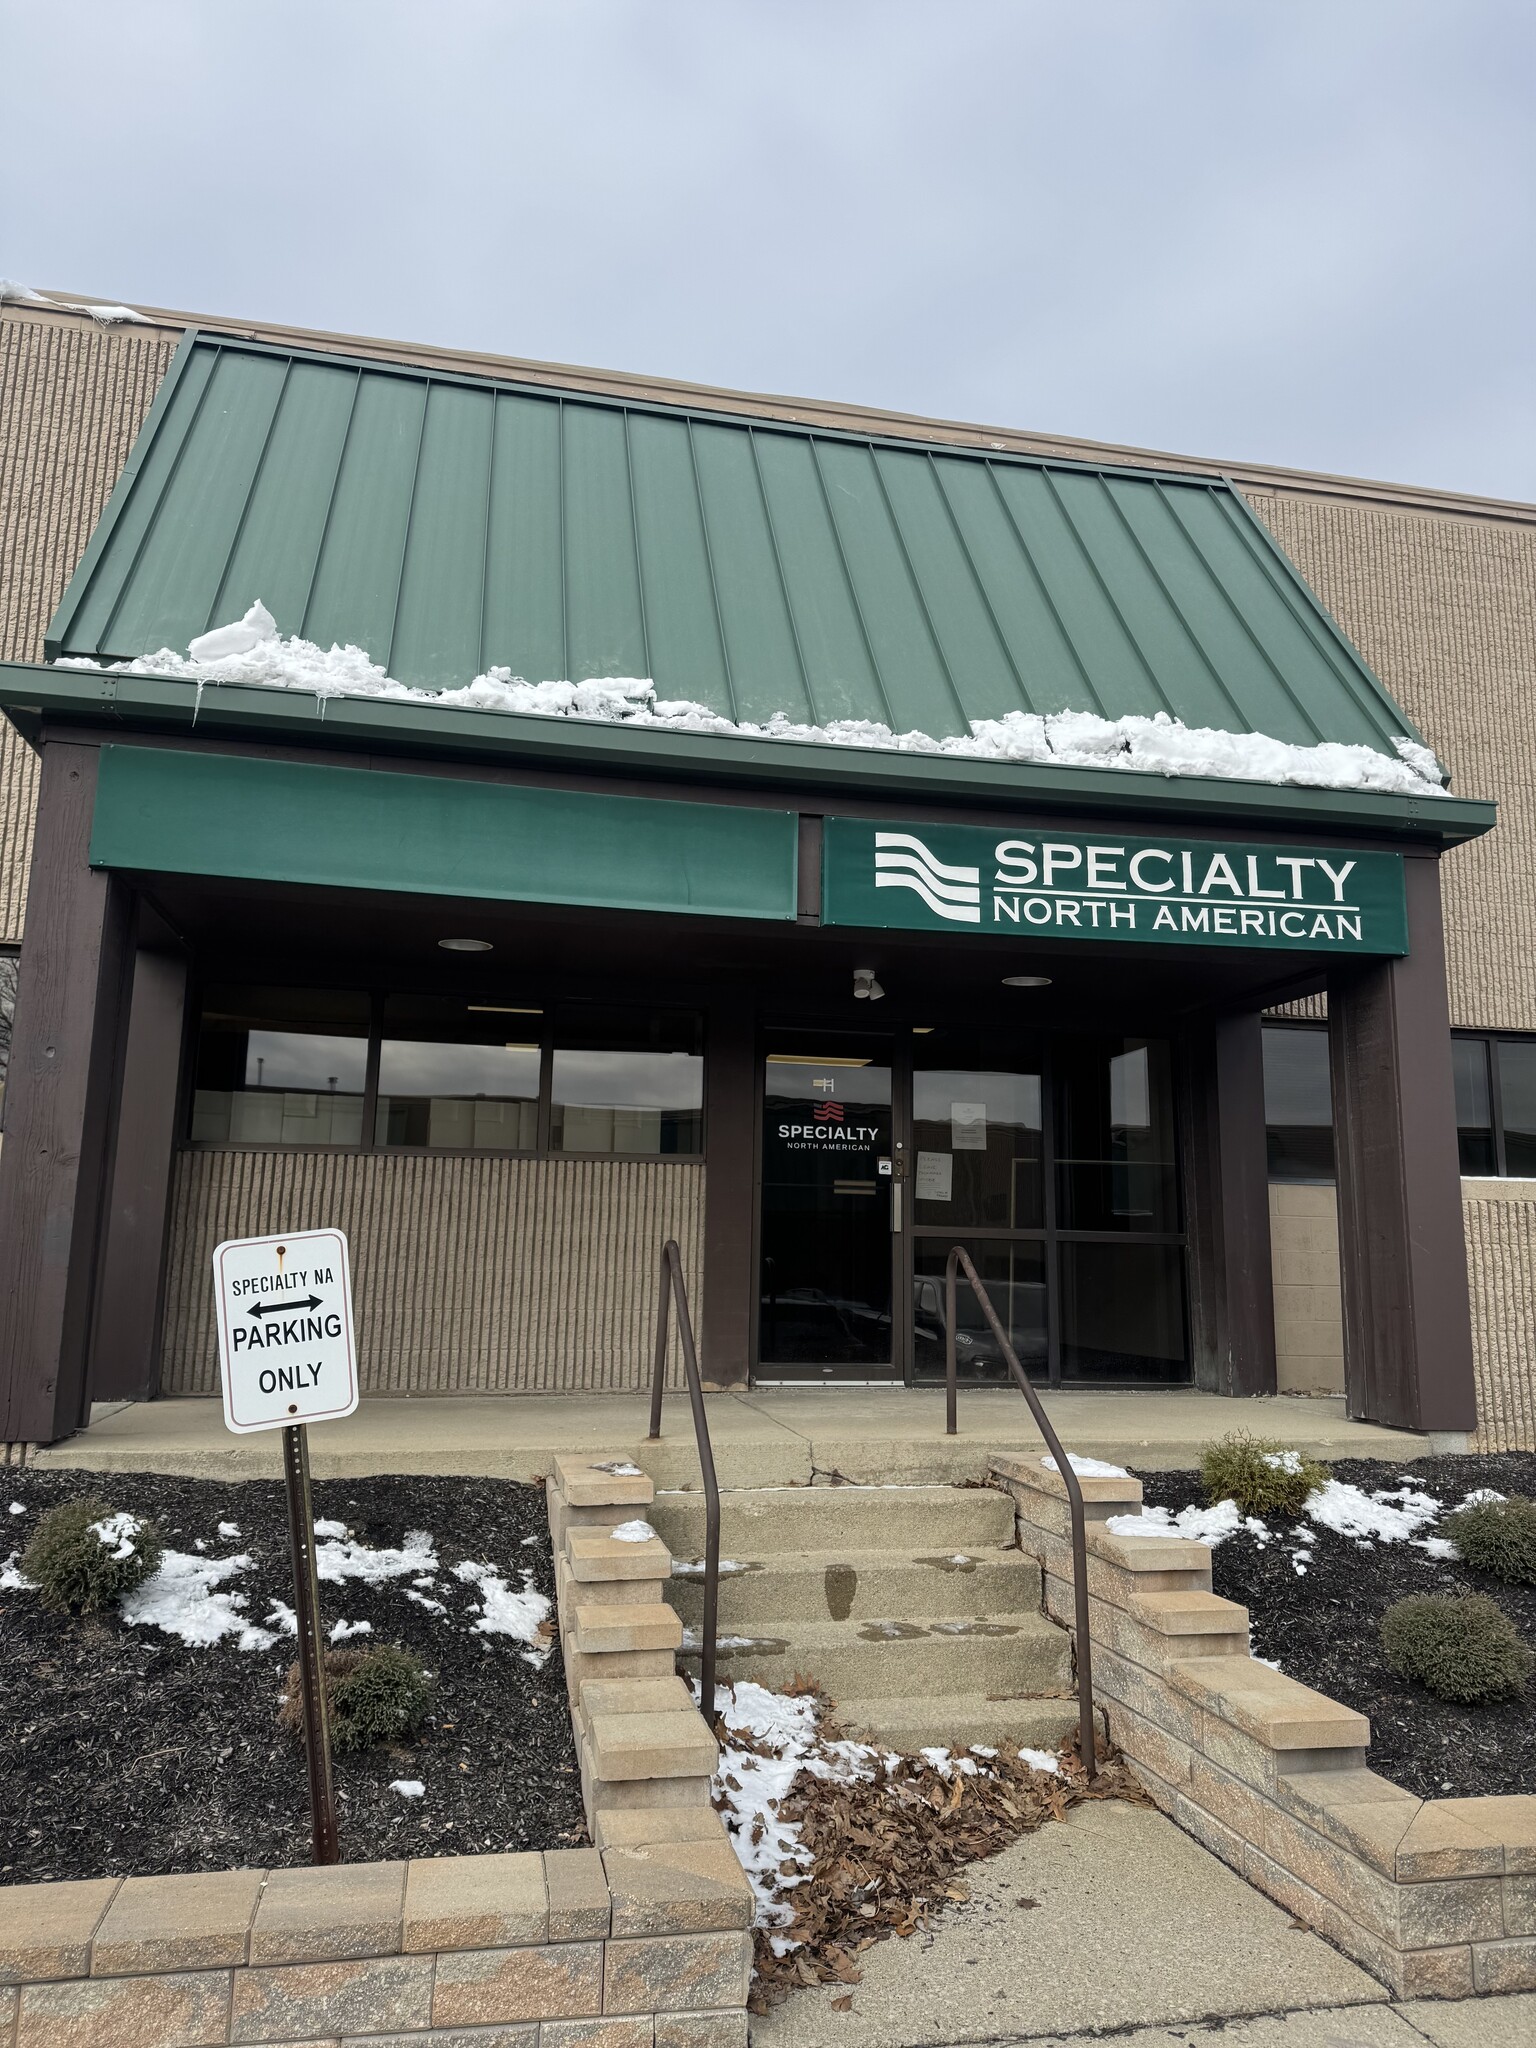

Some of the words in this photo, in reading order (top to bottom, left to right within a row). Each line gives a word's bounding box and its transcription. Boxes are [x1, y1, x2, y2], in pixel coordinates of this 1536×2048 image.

[994, 839, 1358, 902] SPECIALTY
[993, 896, 1136, 929] NORTH
[1152, 905, 1363, 941] AMERICAN
[778, 1124, 879, 1141] SPECIALTY
[787, 1142, 819, 1150] NORTH
[822, 1143, 870, 1151] AMERICAN
[232, 1271, 307, 1296] SPECIALTY
[314, 1267, 334, 1285] NA
[233, 1314, 342, 1352] PARKING
[259, 1362, 323, 1394] ONLY
